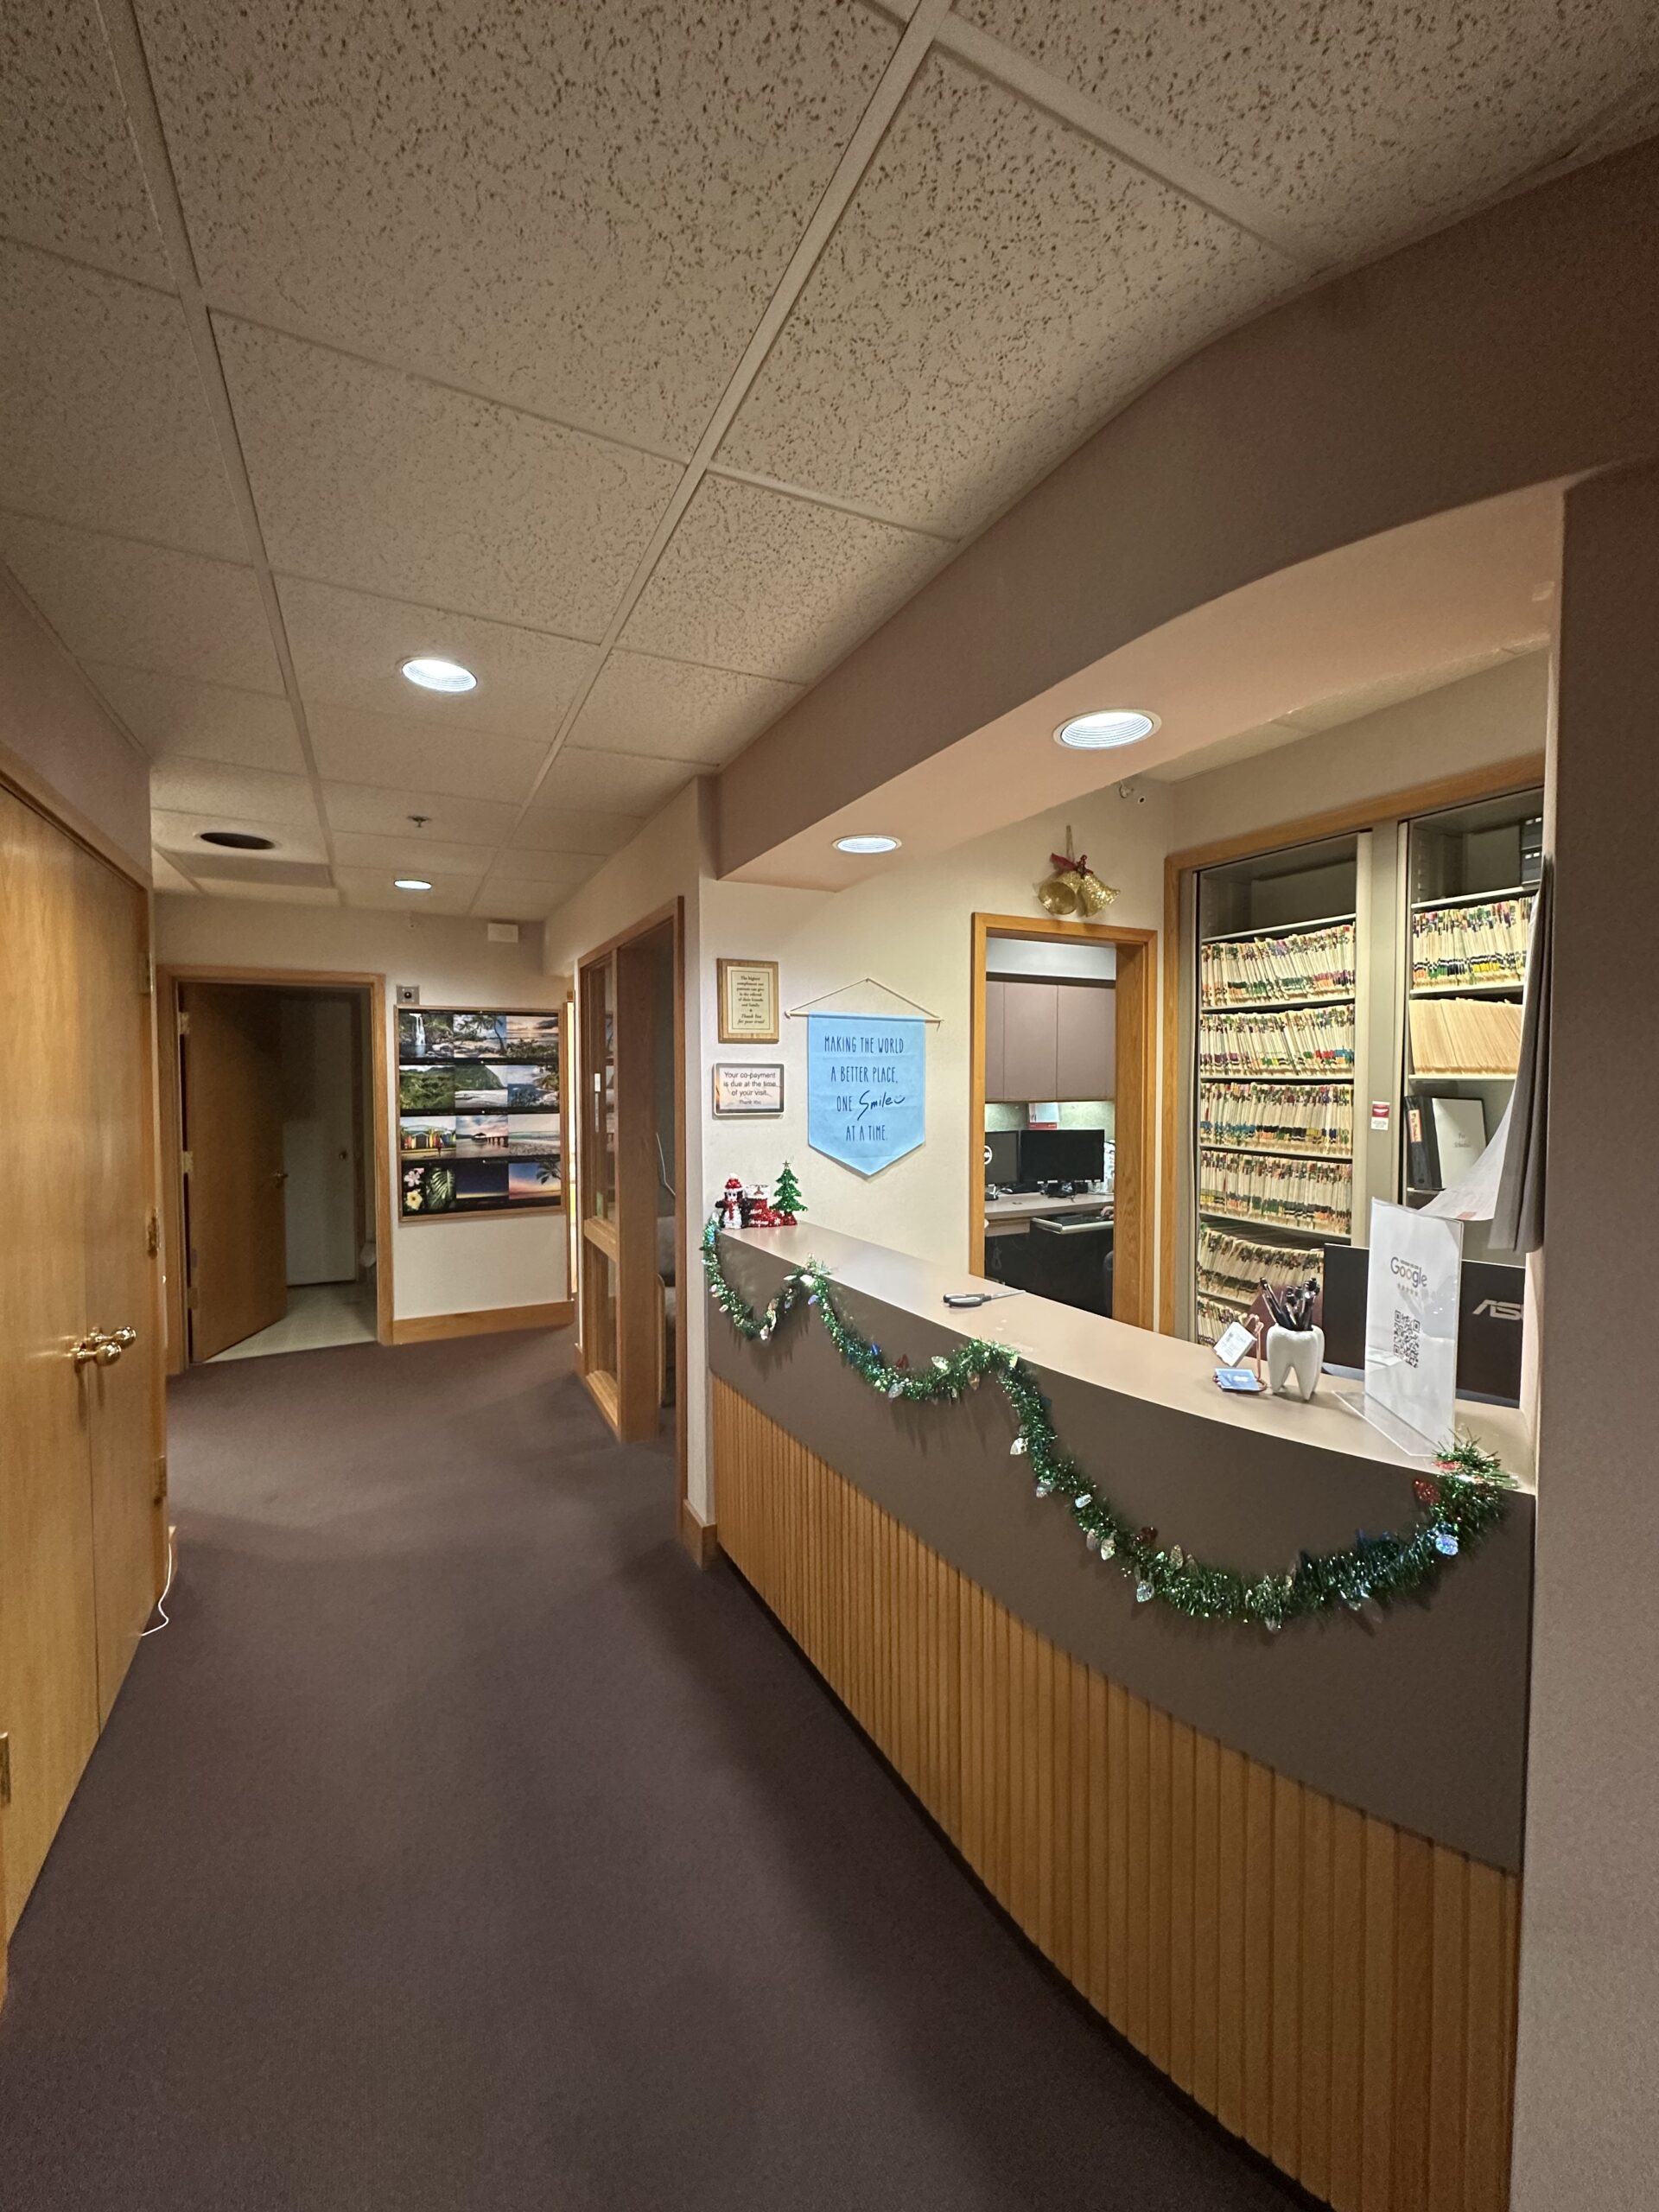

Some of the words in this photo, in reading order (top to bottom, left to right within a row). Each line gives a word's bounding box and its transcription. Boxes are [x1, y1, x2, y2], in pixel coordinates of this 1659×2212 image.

[824, 1036, 856, 1052] MAKING
[861, 1037, 874, 1053] THE
[878, 1038, 904, 1053] WORLD
[830, 1065, 836, 1082] A
[840, 1065, 868, 1083] BETTER
[836, 1096, 853, 1112] ONE
[857, 1090, 893, 1121] Smile
[846, 1125, 855, 1141] AT
[860, 1125, 865, 1141] A
[1390, 1256, 1427, 1288] Google
[1472, 1299, 1523, 1321] AS
